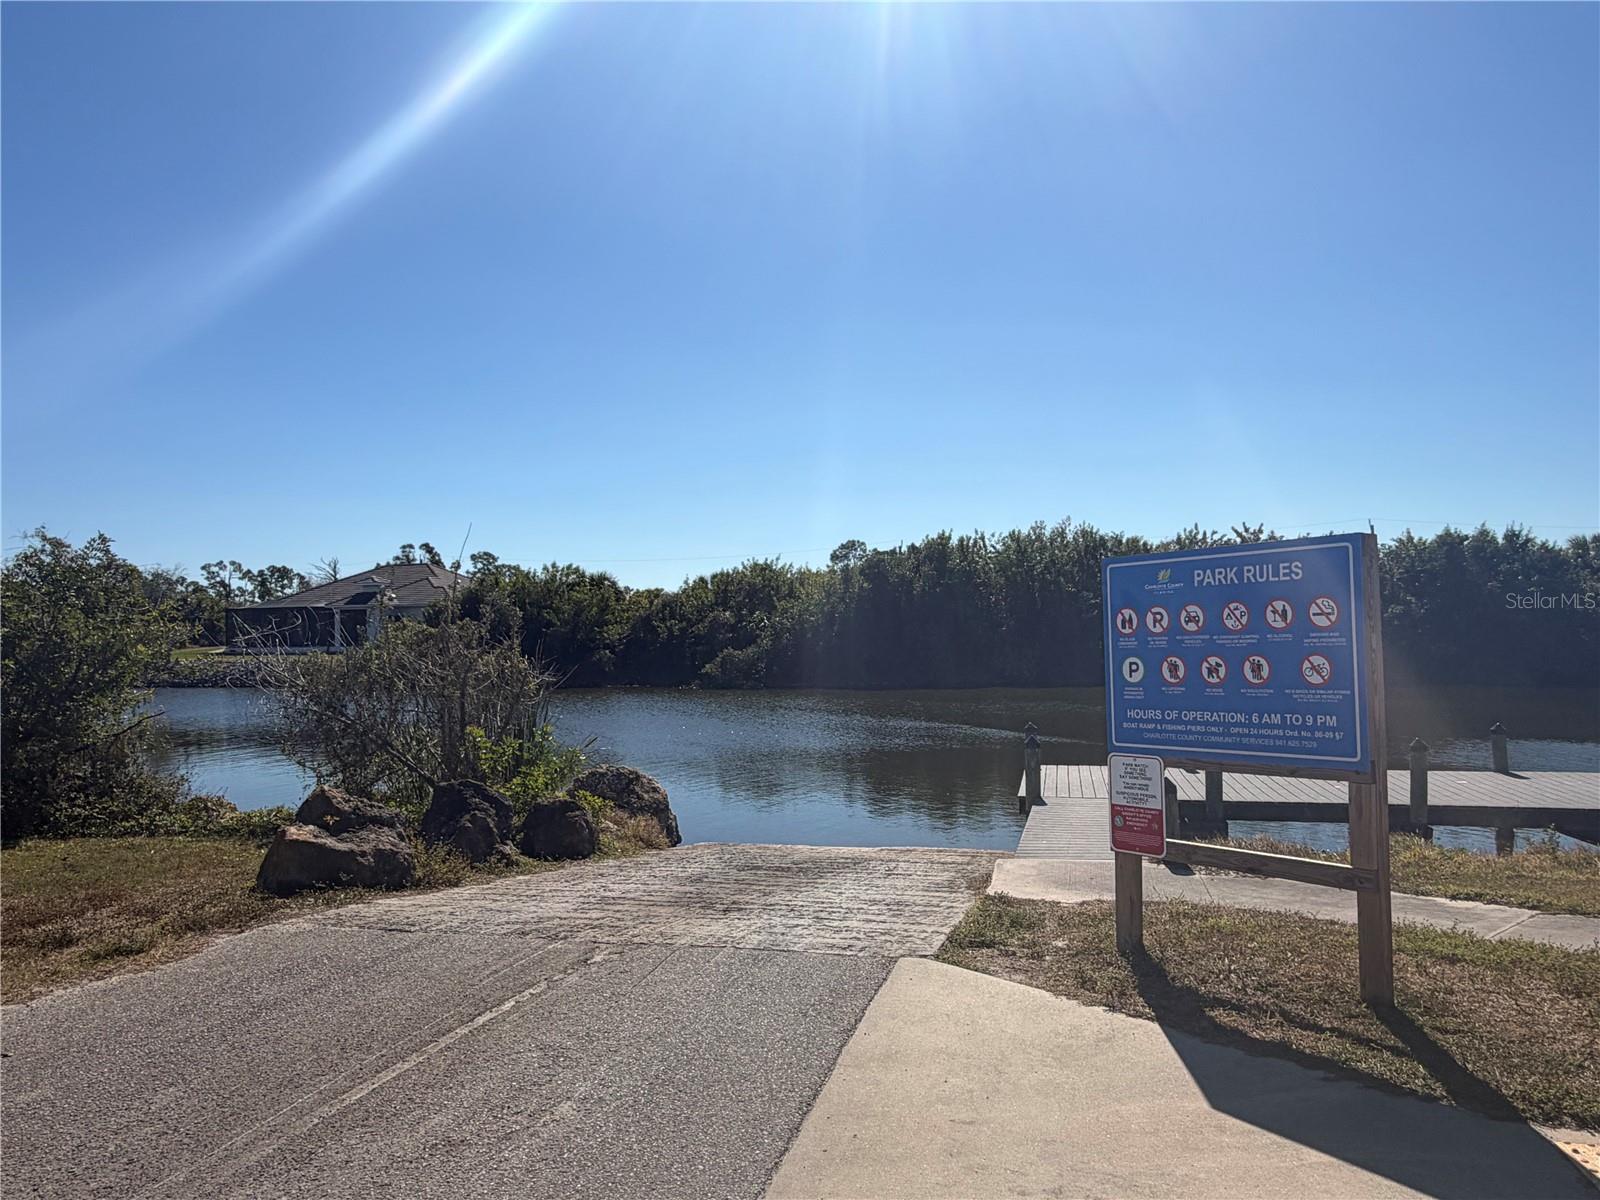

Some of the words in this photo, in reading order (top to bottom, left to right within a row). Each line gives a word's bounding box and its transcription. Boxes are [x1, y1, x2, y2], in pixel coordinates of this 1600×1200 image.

[1194, 566, 1239, 587] PARK
[1243, 561, 1303, 583] RULES
[1129, 662, 1140, 678] P
[1127, 709, 1162, 720] HOURS
[1164, 710, 1179, 720] OF
[1181, 710, 1249, 723] OPERATION:
[1252, 713, 1260, 724] 6
[1262, 713, 1281, 725] AM
[1284, 714, 1303, 725] TO
[1305, 714, 1313, 726] 9
[1316, 715, 1337, 727] PM
[1144, 732, 1176, 740] CHARLOTTE
[1202, 735, 1239, 744] COMMUNITY
[1239, 737, 1273, 746] SERVICES
[1259, 728, 1284, 736] HOURS
